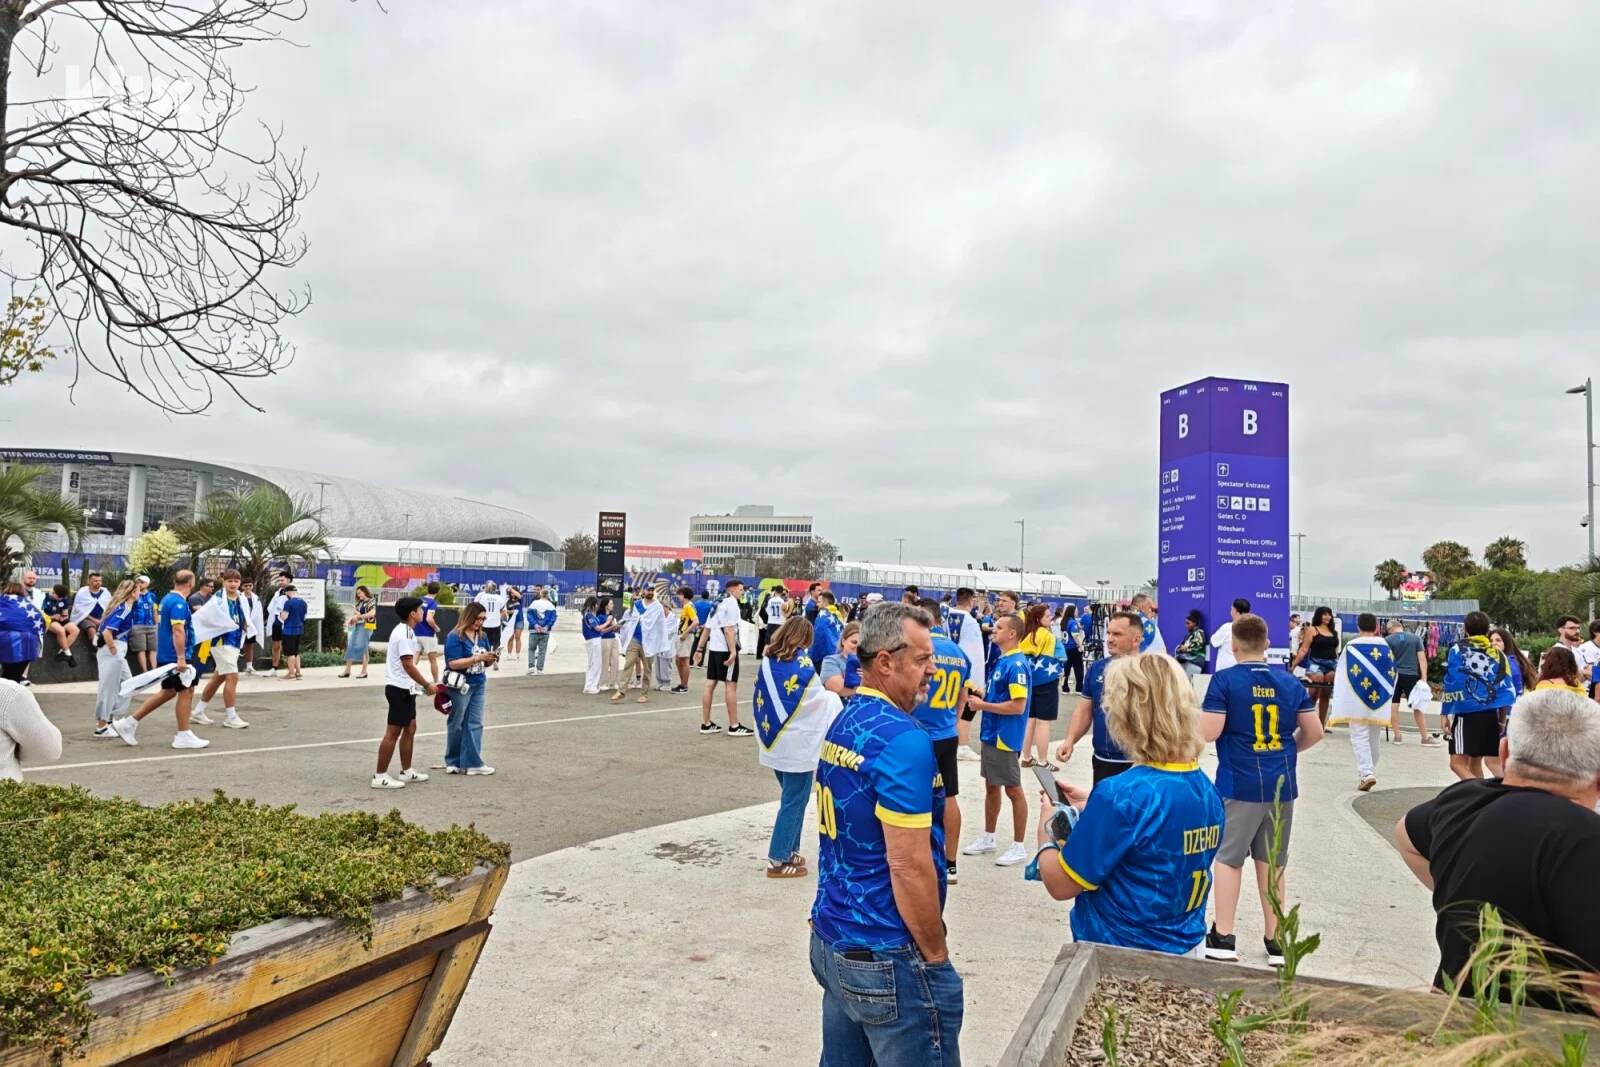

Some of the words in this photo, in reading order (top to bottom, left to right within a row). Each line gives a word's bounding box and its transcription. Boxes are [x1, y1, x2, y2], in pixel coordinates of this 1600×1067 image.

[1178, 413, 1188, 439] B
[1244, 409, 1258, 435] B
[35, 567, 56, 576] FIFA
[488, 602, 495, 612] 11
[772, 605, 780, 617] 11
[930, 668, 960, 709] 20
[1252, 685, 1275, 698] DŽEKO
[1252, 704, 1283, 752] 11
